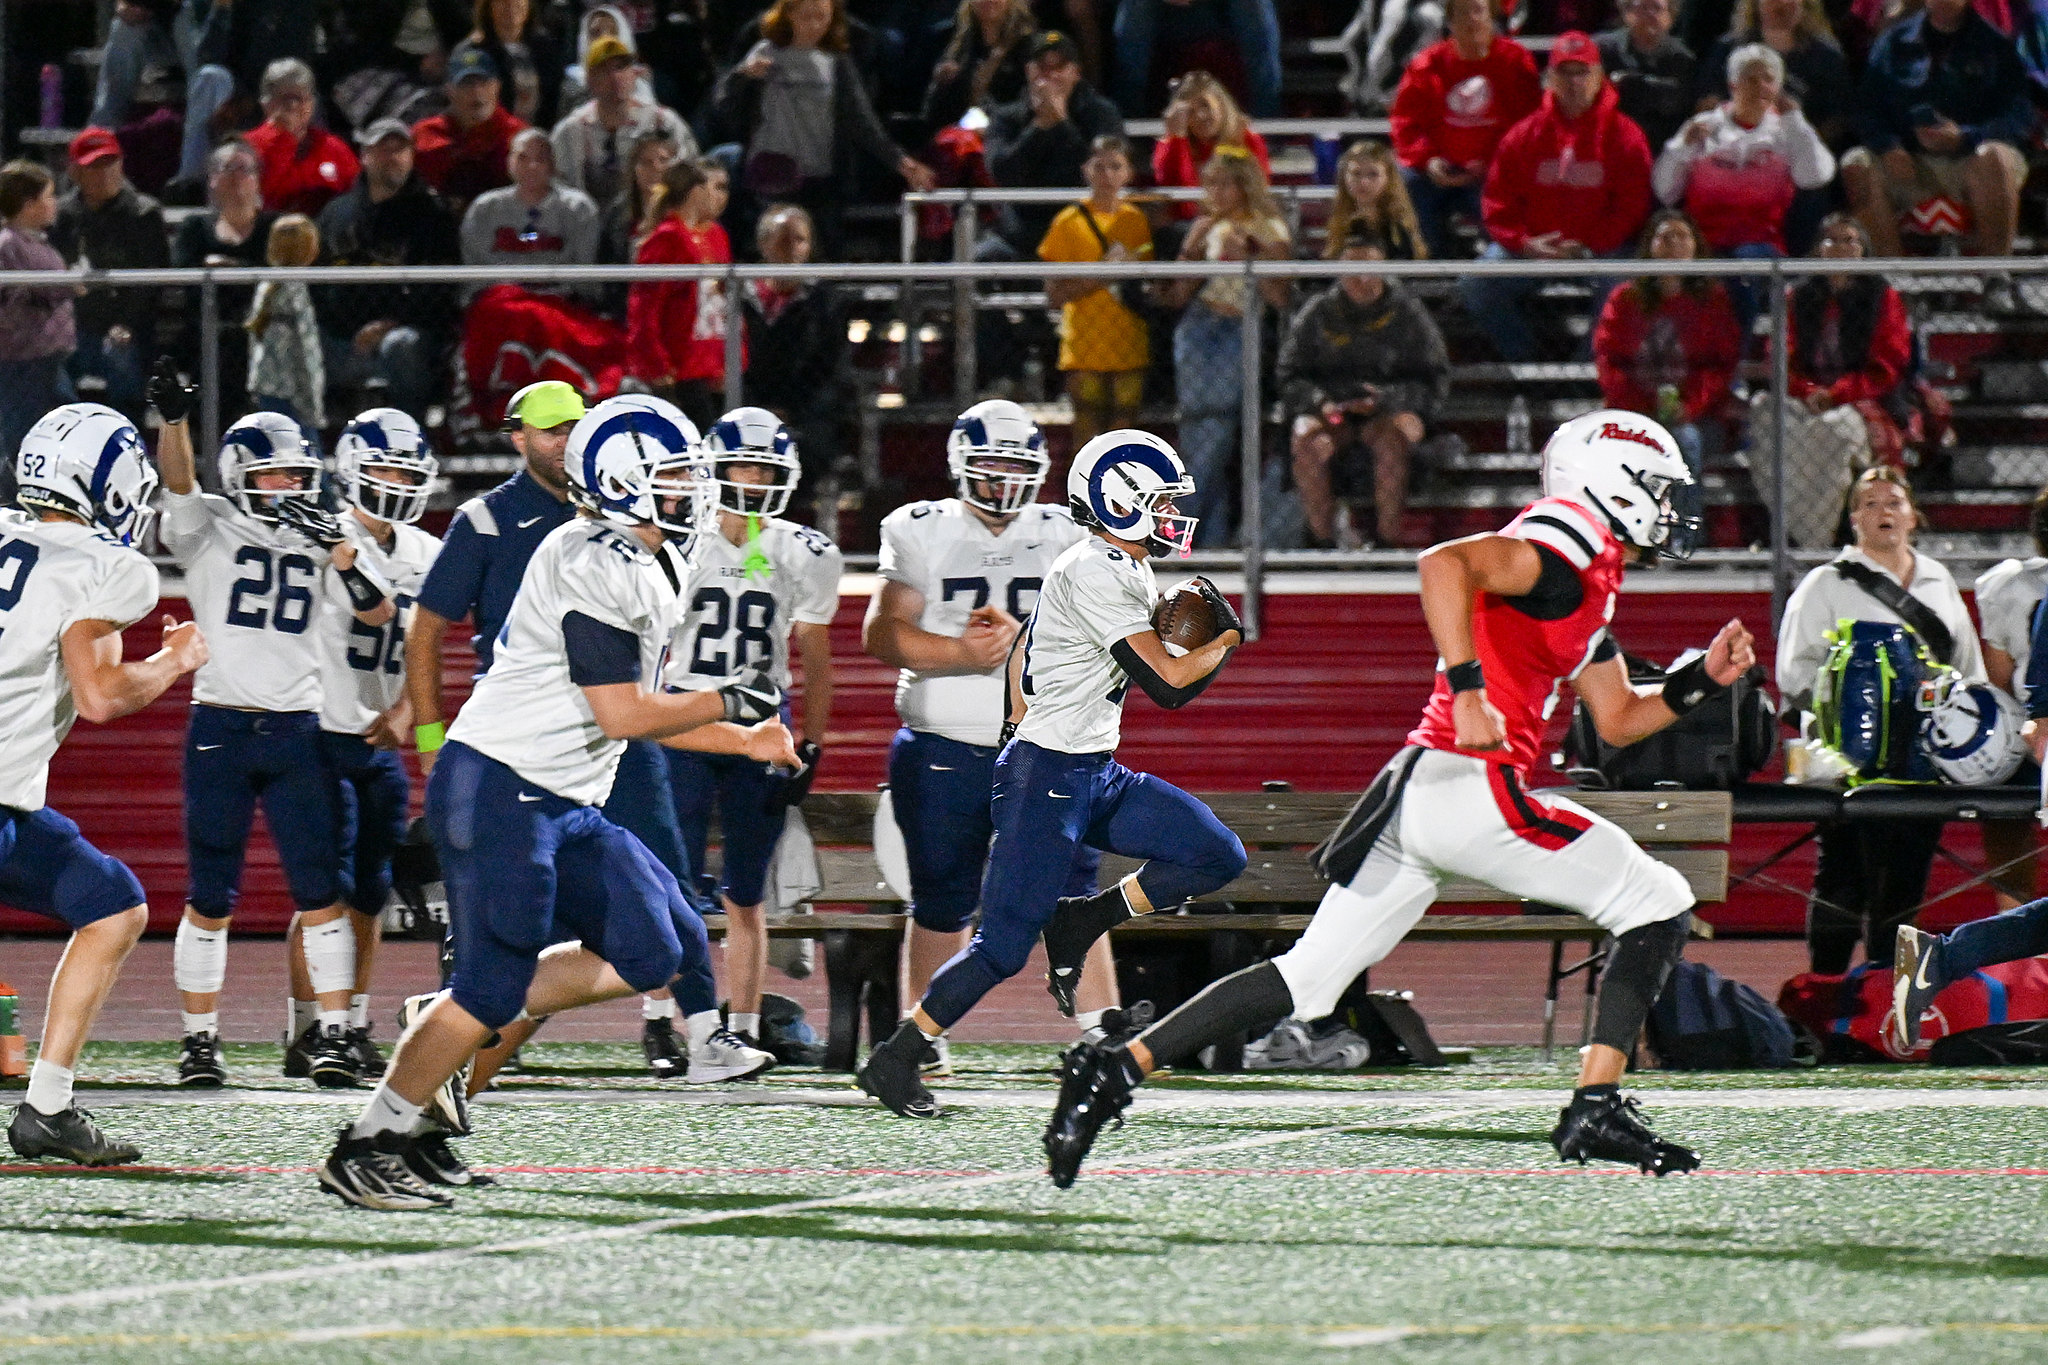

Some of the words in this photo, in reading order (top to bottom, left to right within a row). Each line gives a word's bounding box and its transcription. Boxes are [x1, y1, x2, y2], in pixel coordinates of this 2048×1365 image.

[24, 453, 45, 478] 52
[226, 544, 315, 634] 26
[690, 587, 775, 676] 28
